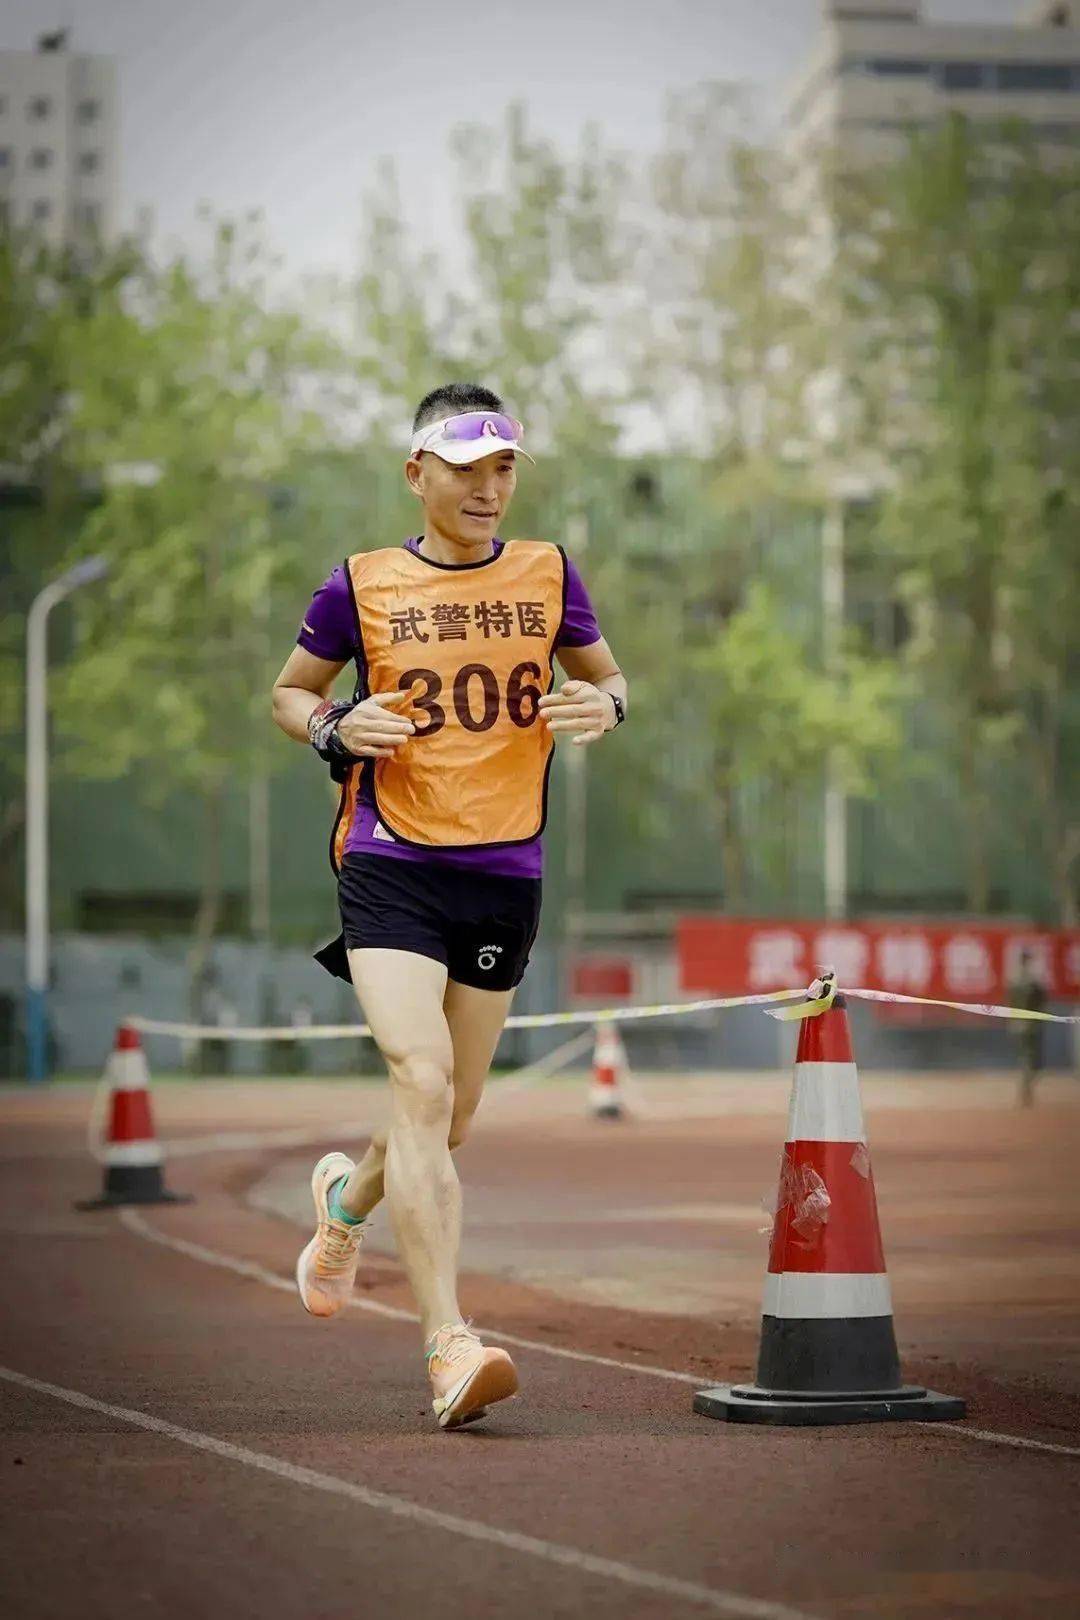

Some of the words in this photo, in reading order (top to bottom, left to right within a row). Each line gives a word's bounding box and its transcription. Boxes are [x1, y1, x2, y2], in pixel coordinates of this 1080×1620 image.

[389, 600, 548, 645] 武警特医
[398, 661, 542, 737] 306
